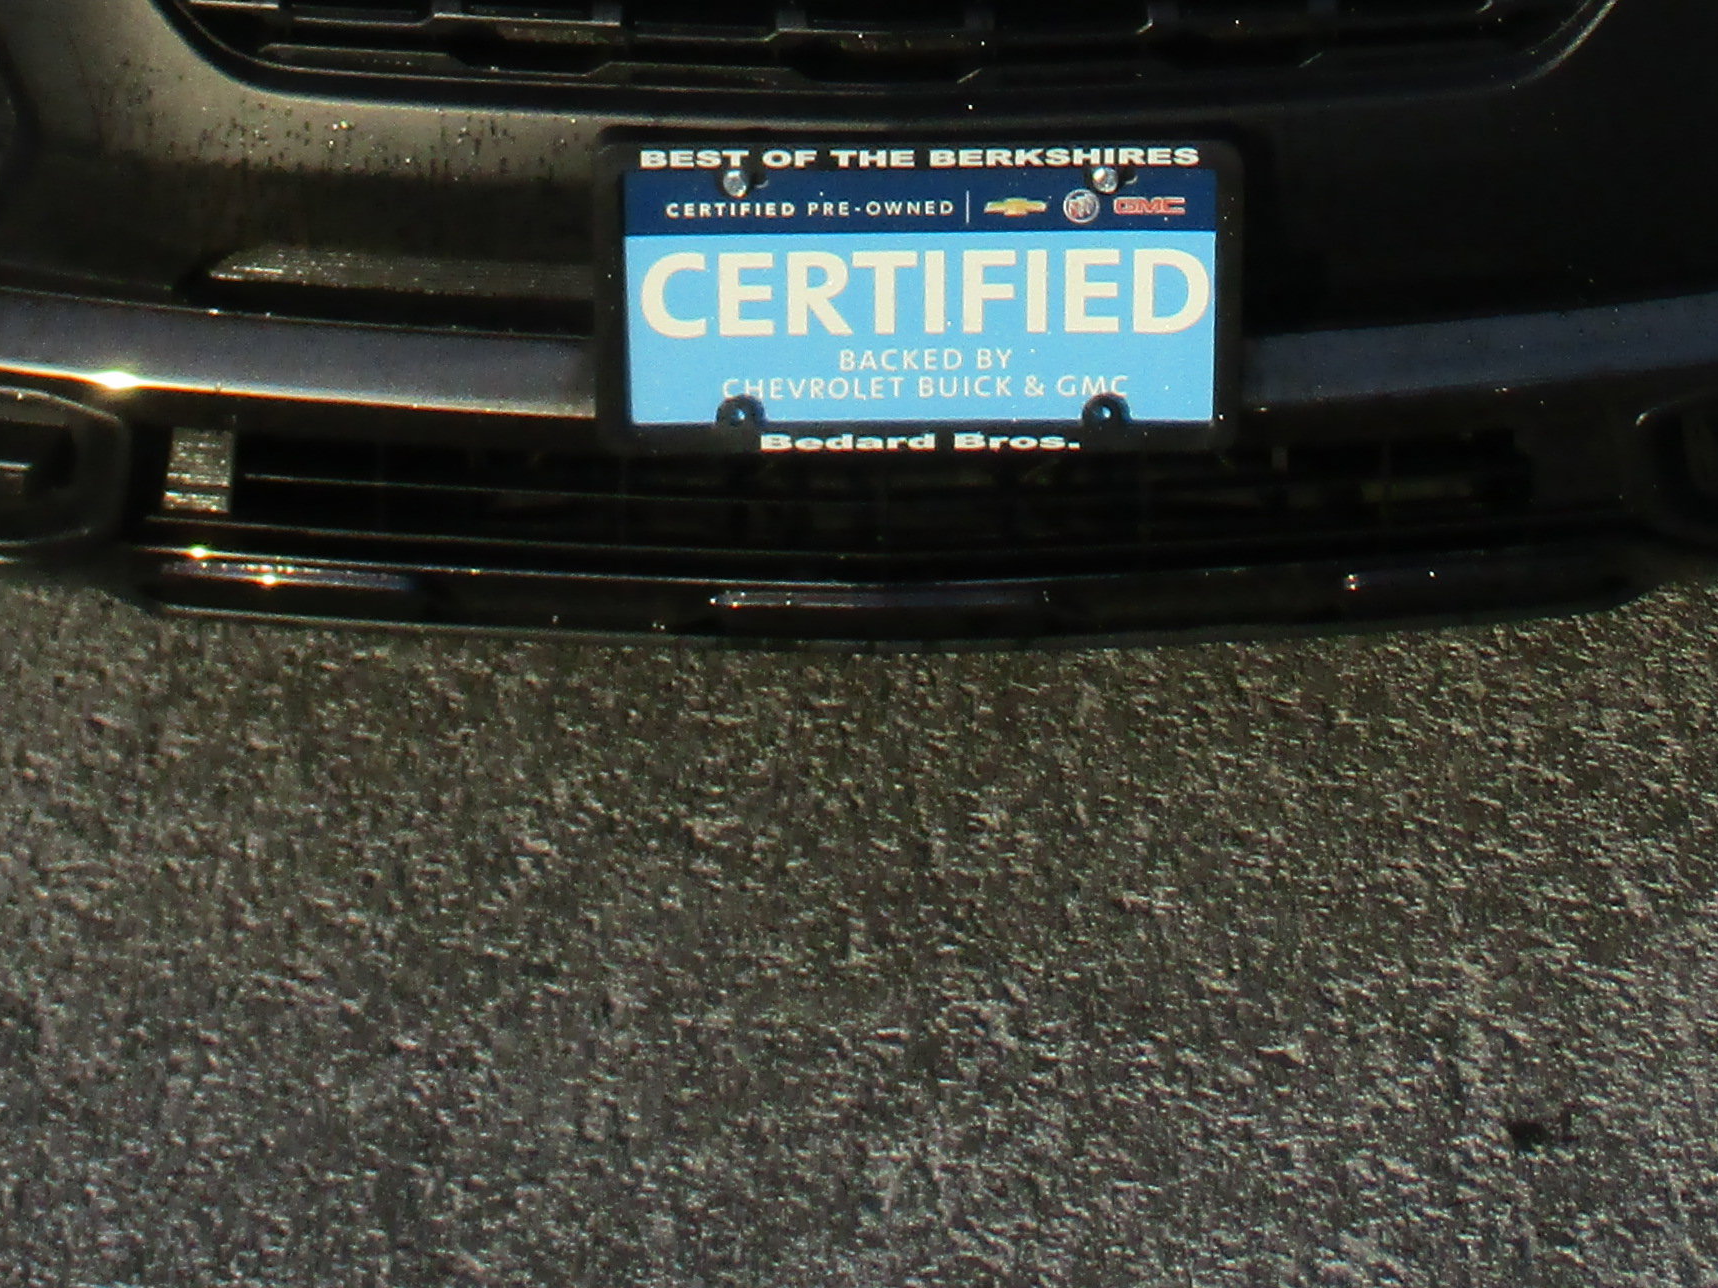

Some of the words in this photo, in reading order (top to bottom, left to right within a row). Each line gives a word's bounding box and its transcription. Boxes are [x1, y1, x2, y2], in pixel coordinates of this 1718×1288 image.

[640, 149, 750, 168] BEST
[762, 149, 818, 168] OF
[830, 149, 916, 168] THE
[929, 147, 1200, 167] BERKSHIRES
[666, 202, 795, 218] CERTIFIED
[807, 199, 954, 217] PRE-OWNED
[1113, 196, 1186, 215] GMC
[641, 249, 1210, 336] CERTIFIED
[839, 349, 963, 372] BACKED
[976, 348, 1012, 370] BY
[722, 377, 904, 401] CHEVROLET
[918, 375, 1012, 398] BUICK
[1024, 374, 1045, 397] &
[1056, 375, 1129, 397] GMC
[760, 432, 936, 452] Bedard
[954, 431, 1081, 452] Bros.
